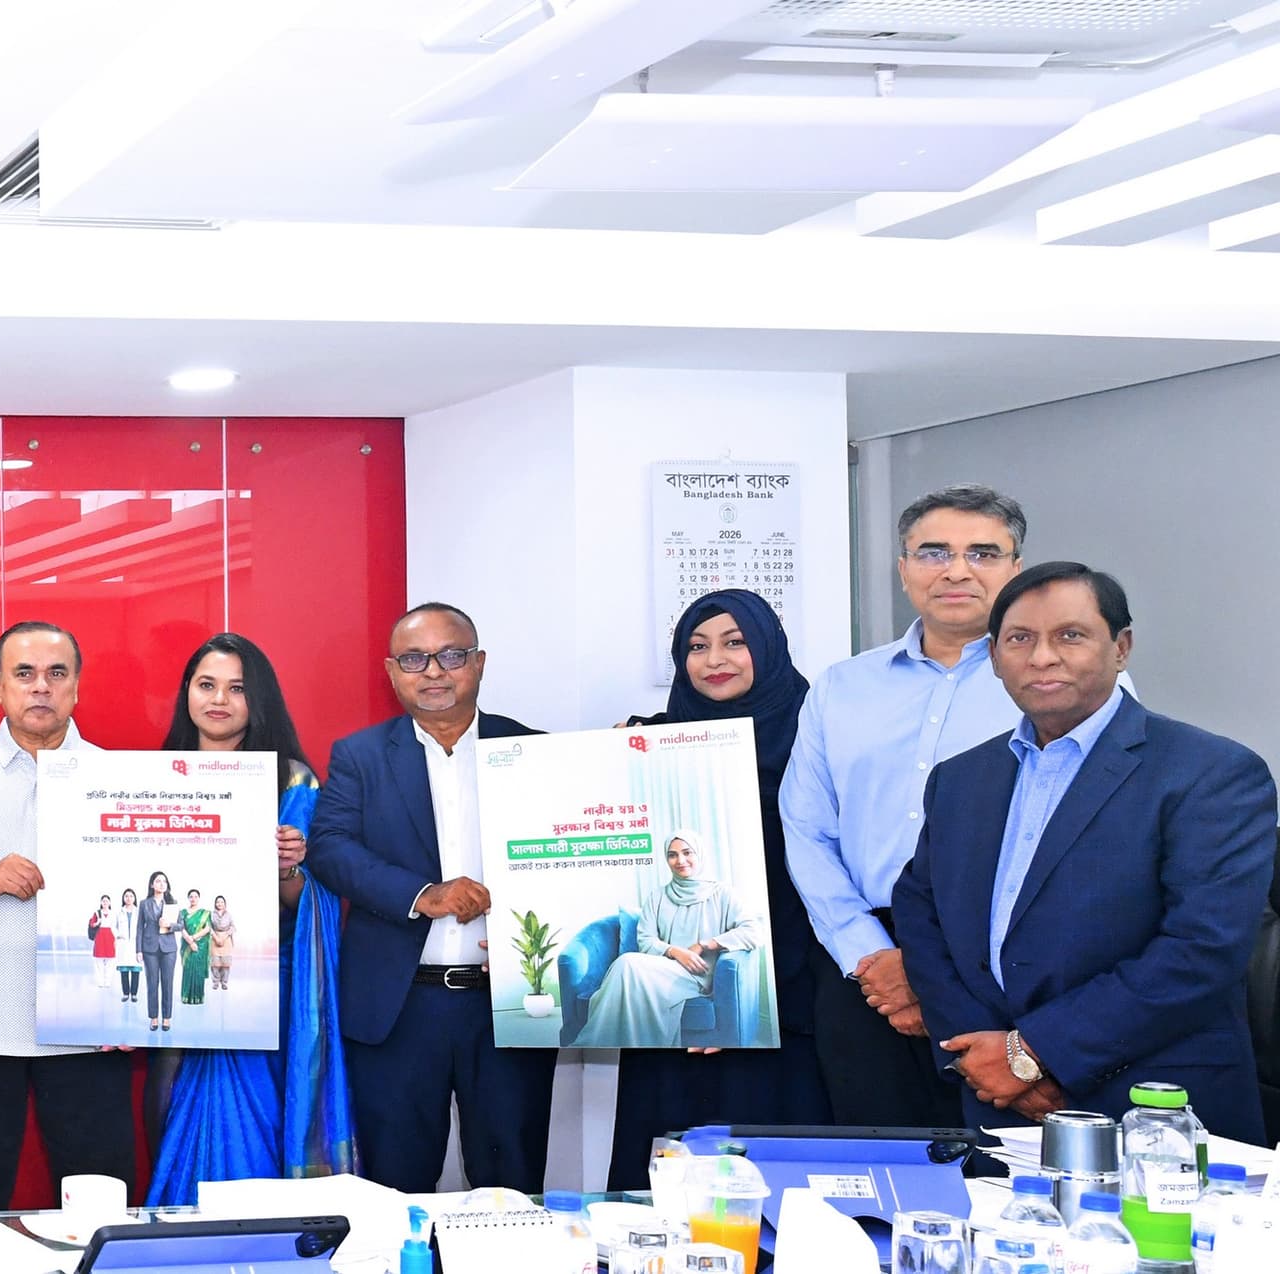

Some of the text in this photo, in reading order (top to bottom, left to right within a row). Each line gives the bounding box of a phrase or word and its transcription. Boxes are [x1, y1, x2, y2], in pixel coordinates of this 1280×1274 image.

[664, 472, 790, 489] বাংলাদেশ ব্যাংক
[683, 491, 743, 499] Bangladesh
[719, 530, 742, 539] 2026
[666, 548, 675, 556] 31
[679, 548, 684, 556] 3
[689, 548, 696, 556] 10
[700, 548, 707, 556] 17
[709, 548, 718, 556] 24
[753, 548, 758, 556] 7
[762, 548, 770, 556] 14
[773, 548, 781, 556] 21
[784, 548, 792, 556] 28
[679, 575, 685, 583] 5
[689, 575, 697, 583] 12
[700, 575, 708, 583] 19
[710, 575, 720, 583] 26
[744, 575, 748, 583] 2
[754, 575, 759, 583] 9
[764, 575, 771, 583] 16
[773, 575, 782, 583] 23
[784, 575, 794, 583] 30
[680, 601, 783, 609] 7 25
[198, 761, 264, 770] midlandbank
[584, 804, 613, 816] নারীর
[639, 804, 647, 812] ও
[553, 817, 648, 835] সুরক্ষার বিশ্বস্ত সঙ্গী
[511, 837, 648, 855] সালাম নারী সুরক্ষা ডিপিএস
[509, 862, 533, 871] আজই
[553, 861, 575, 869] করুন
[577, 860, 602, 868] হালাল
